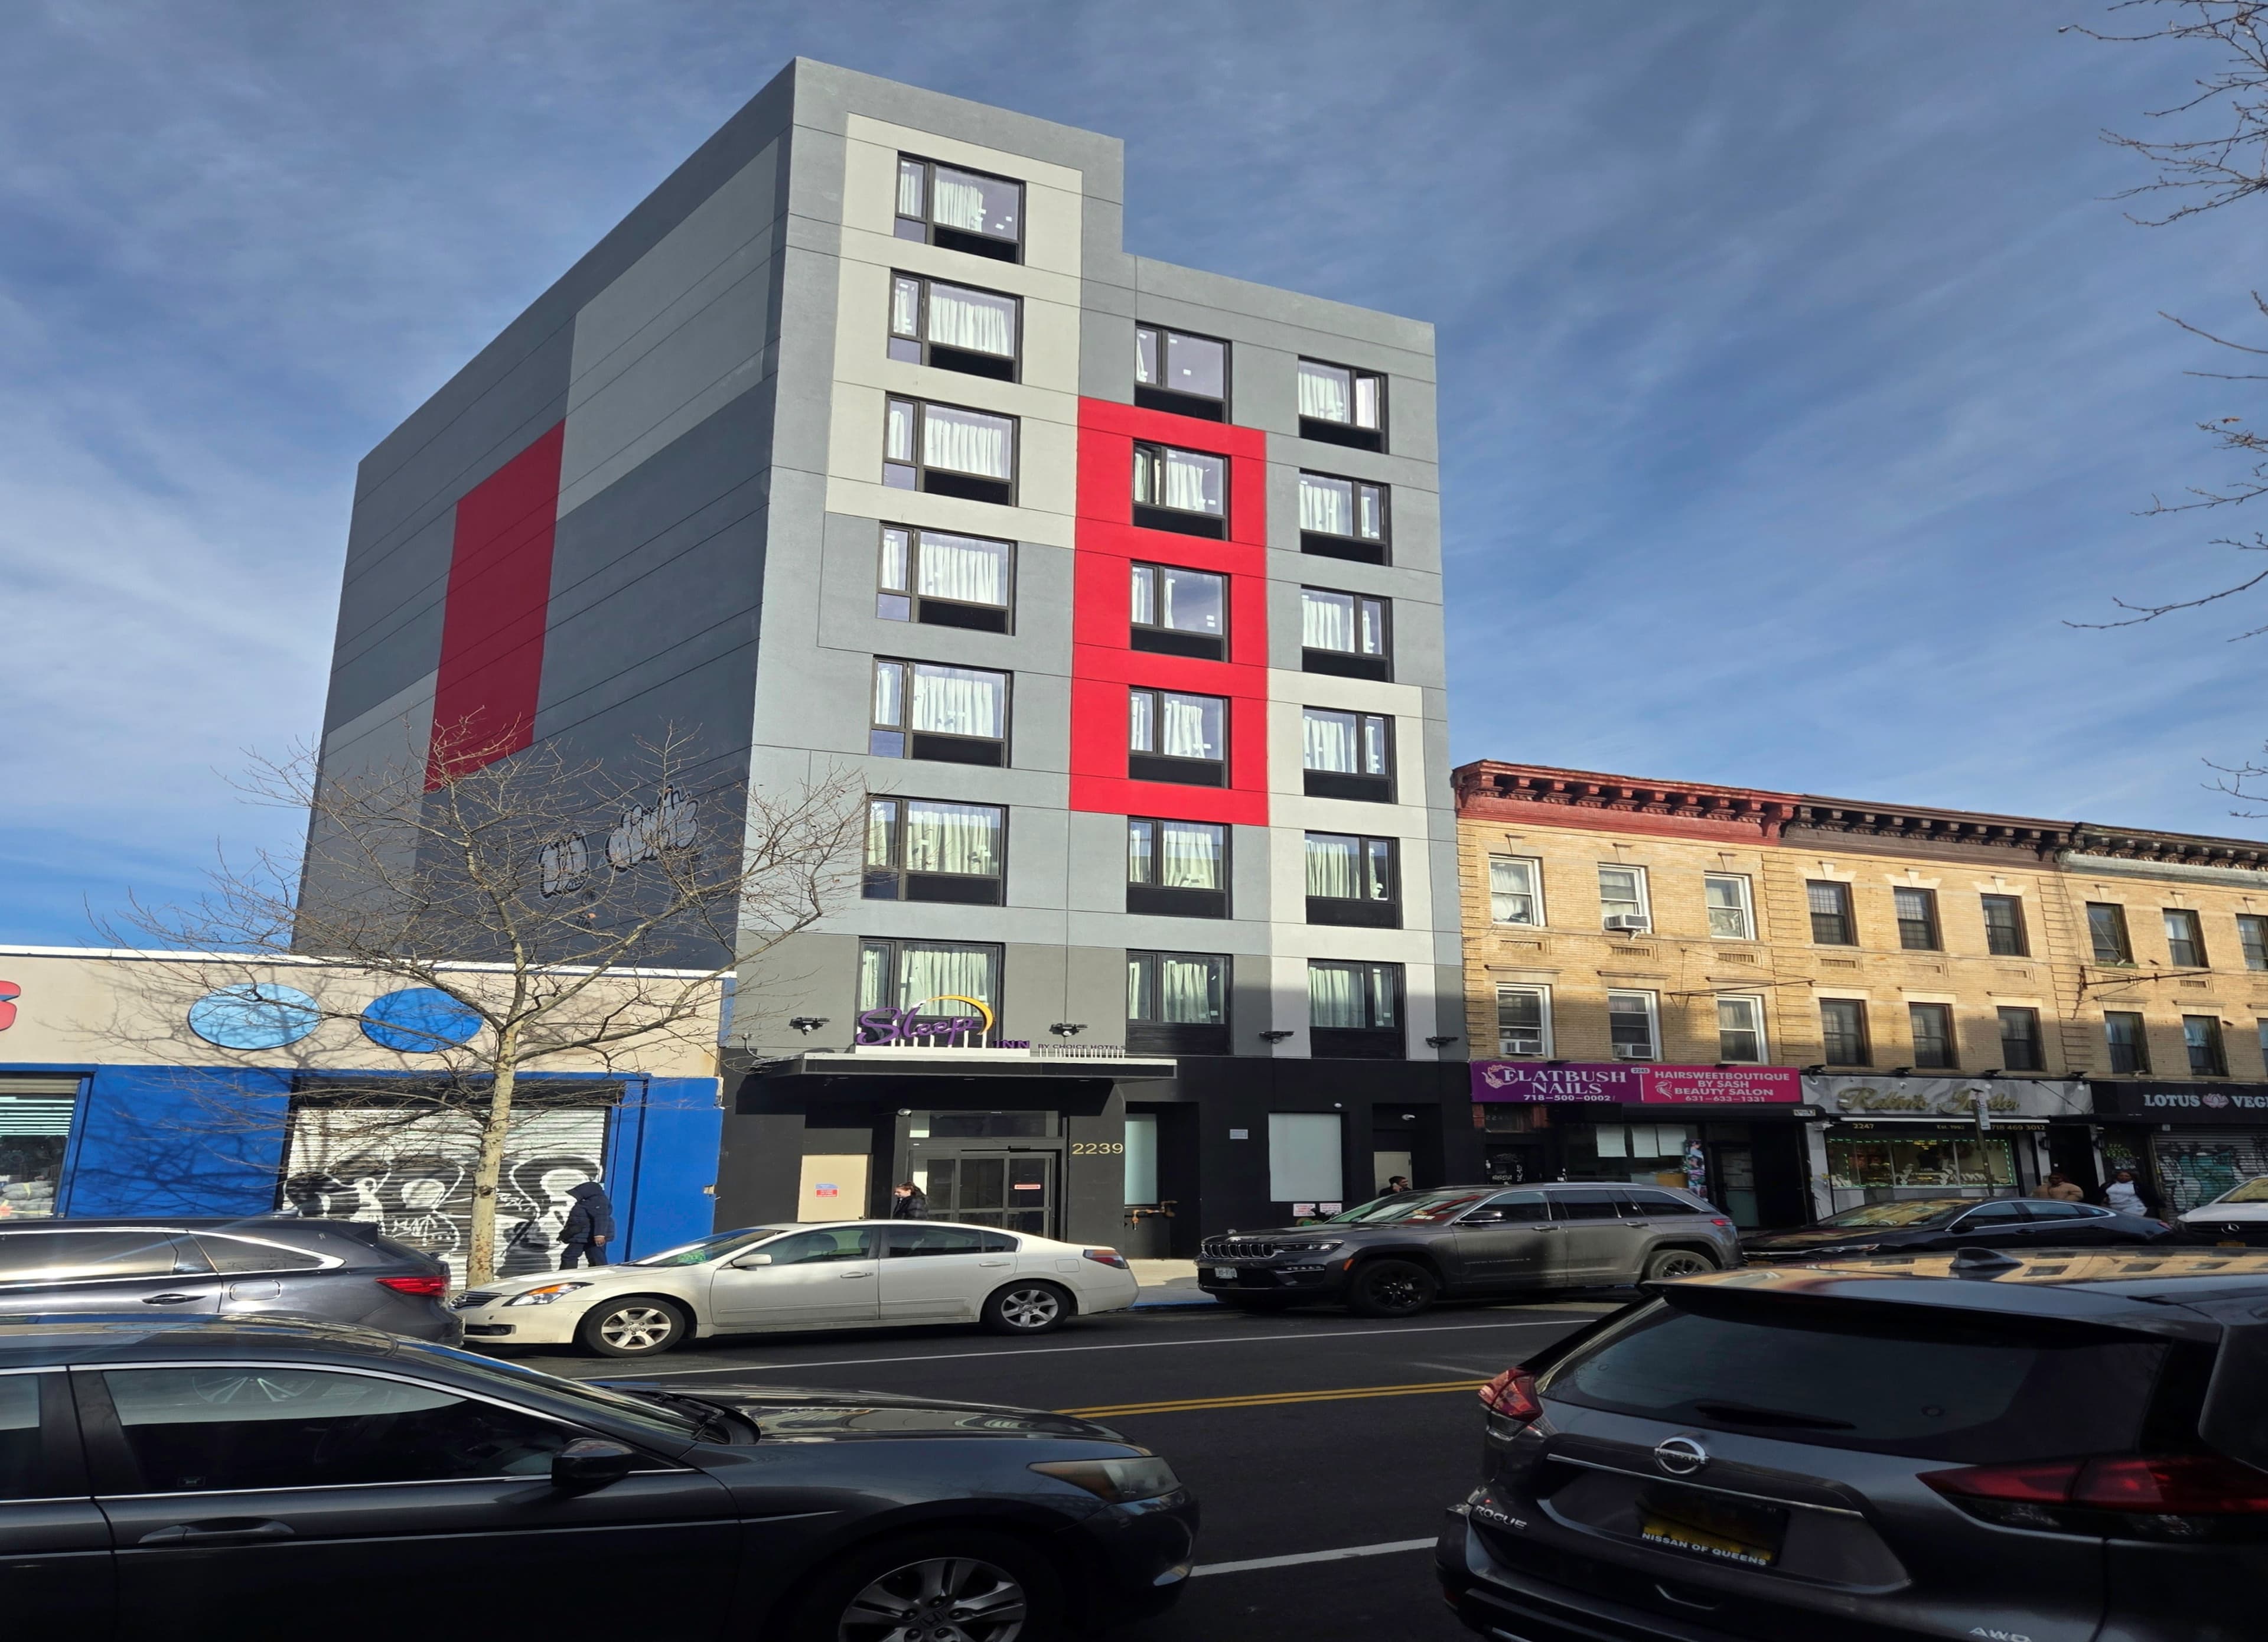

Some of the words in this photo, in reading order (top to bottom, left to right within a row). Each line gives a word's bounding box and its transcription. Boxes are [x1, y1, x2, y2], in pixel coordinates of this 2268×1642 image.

[856, 1005, 979, 1045] Sleep
[995, 1040, 1029, 1048] INN
[1504, 1070, 1627, 1083] FLATBUSH
[1655, 1071, 1790, 1081] HAIRSWEETBOUTIQUE
[1531, 1083, 1602, 1094] NAILS
[2143, 1094, 2201, 1107] LOTUS
[1072, 1143, 1123, 1154] 2239
[1477, 1506, 1527, 1529] ROGUE
[1641, 1532, 1688, 1548] NISSAN
[1691, 1543, 1709, 1553] OF
[1712, 1548, 1767, 1565] QUEENS
[1969, 1627, 2032, 1642] AWD
